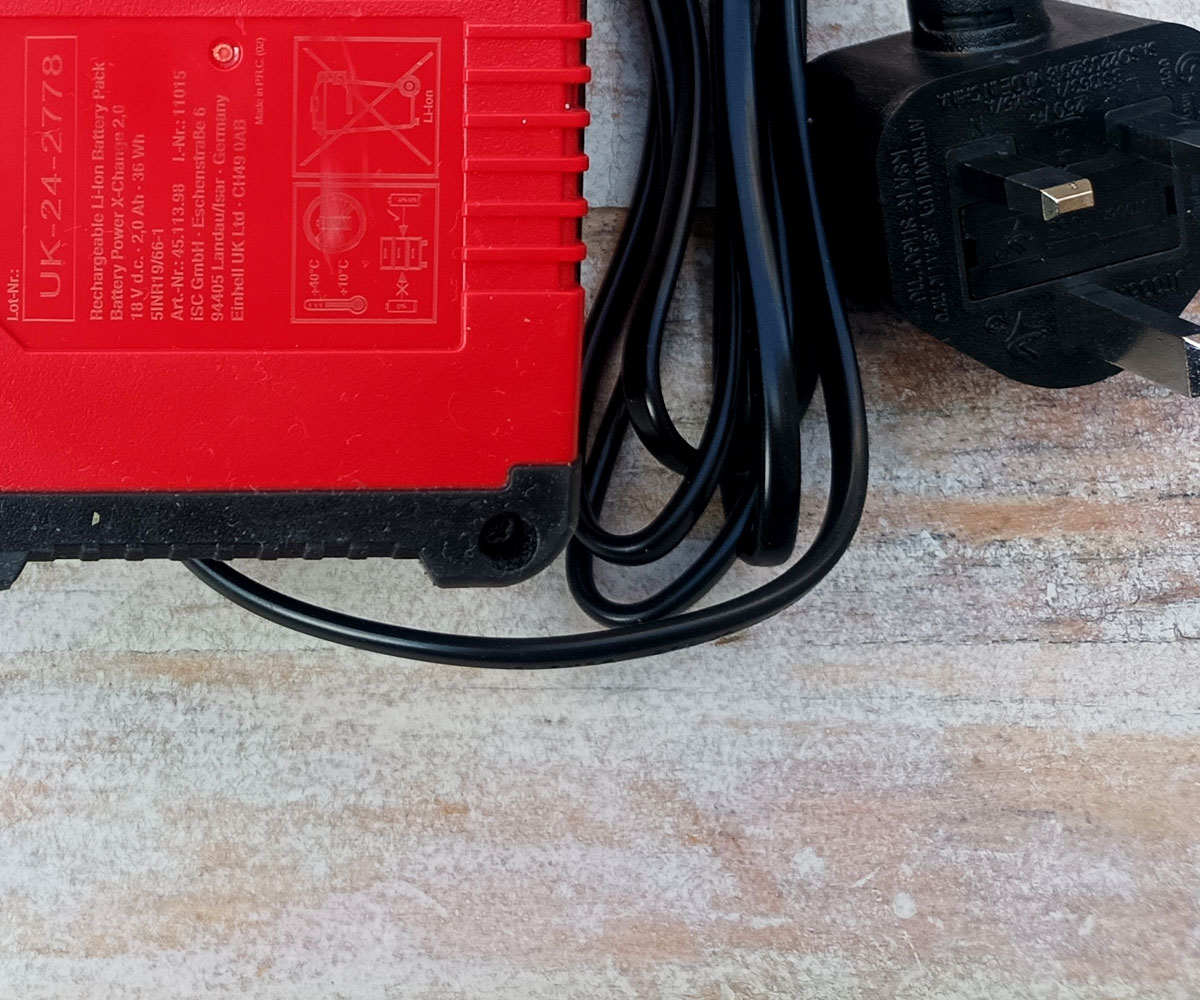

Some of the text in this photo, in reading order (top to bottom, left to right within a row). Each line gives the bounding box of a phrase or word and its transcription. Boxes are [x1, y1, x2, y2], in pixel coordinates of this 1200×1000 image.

[256, 37, 266, 56] (02)
[172, 71, 187, 115] 11015
[193, 107, 206, 117] 6
[255, 88, 264, 96] in
[255, 99, 264, 125] Made
[423, 90, 434, 123] Li-Ion
[39, 53, 63, 298] UK-24-2778
[90, 62, 108, 320] Rechargeable Li-Ion Battery Pack
[233, 156, 245, 197] CH49
[111, 104, 128, 320] Battery Power X-Change 2,0
[131, 134, 147, 320] 18 V d.c. 2,0 Ah 36 Wh
[172, 184, 185, 258] 45.113.98
[212, 95, 229, 321] 94405 Landau/Isar Germany
[232, 211, 245, 236] Ltd
[151, 228, 164, 320] 5INR19/66-1
[191, 241, 204, 289] GmbH
[232, 240, 245, 264] UK
[7, 269, 19, 321] Lot-Nr.:
[172, 261, 185, 321] Art.-Nr.:
[232, 268, 244, 321] Einhell
[338, 259, 349, 296] +10°C
[191, 295, 203, 321] iSC
